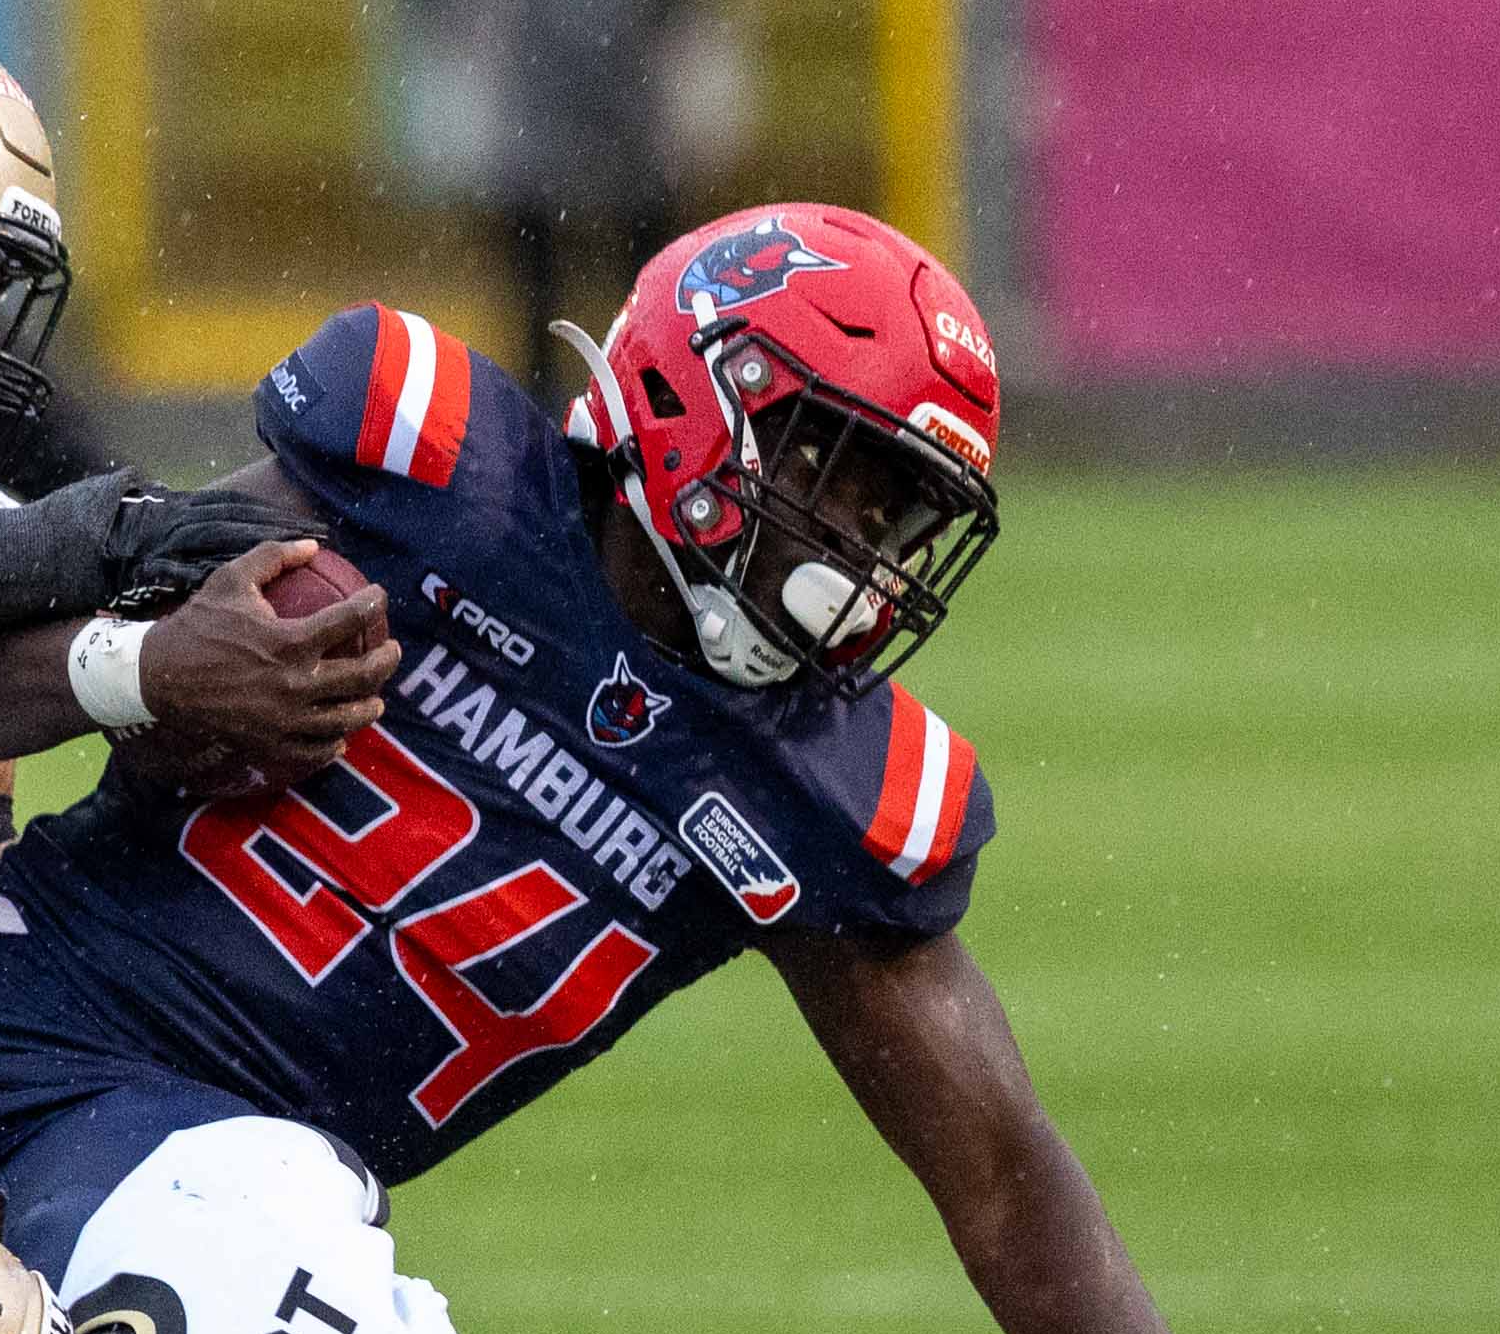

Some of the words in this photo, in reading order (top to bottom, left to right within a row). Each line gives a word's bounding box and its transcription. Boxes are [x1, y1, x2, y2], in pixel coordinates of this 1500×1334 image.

[400, 644, 692, 911] HAMBURG
[692, 824, 739, 876] FOOTBALL
[701, 815, 739, 857] LEAGUE
[709, 805, 759, 860] EUROPEAN
[182, 722, 660, 1129] 24
